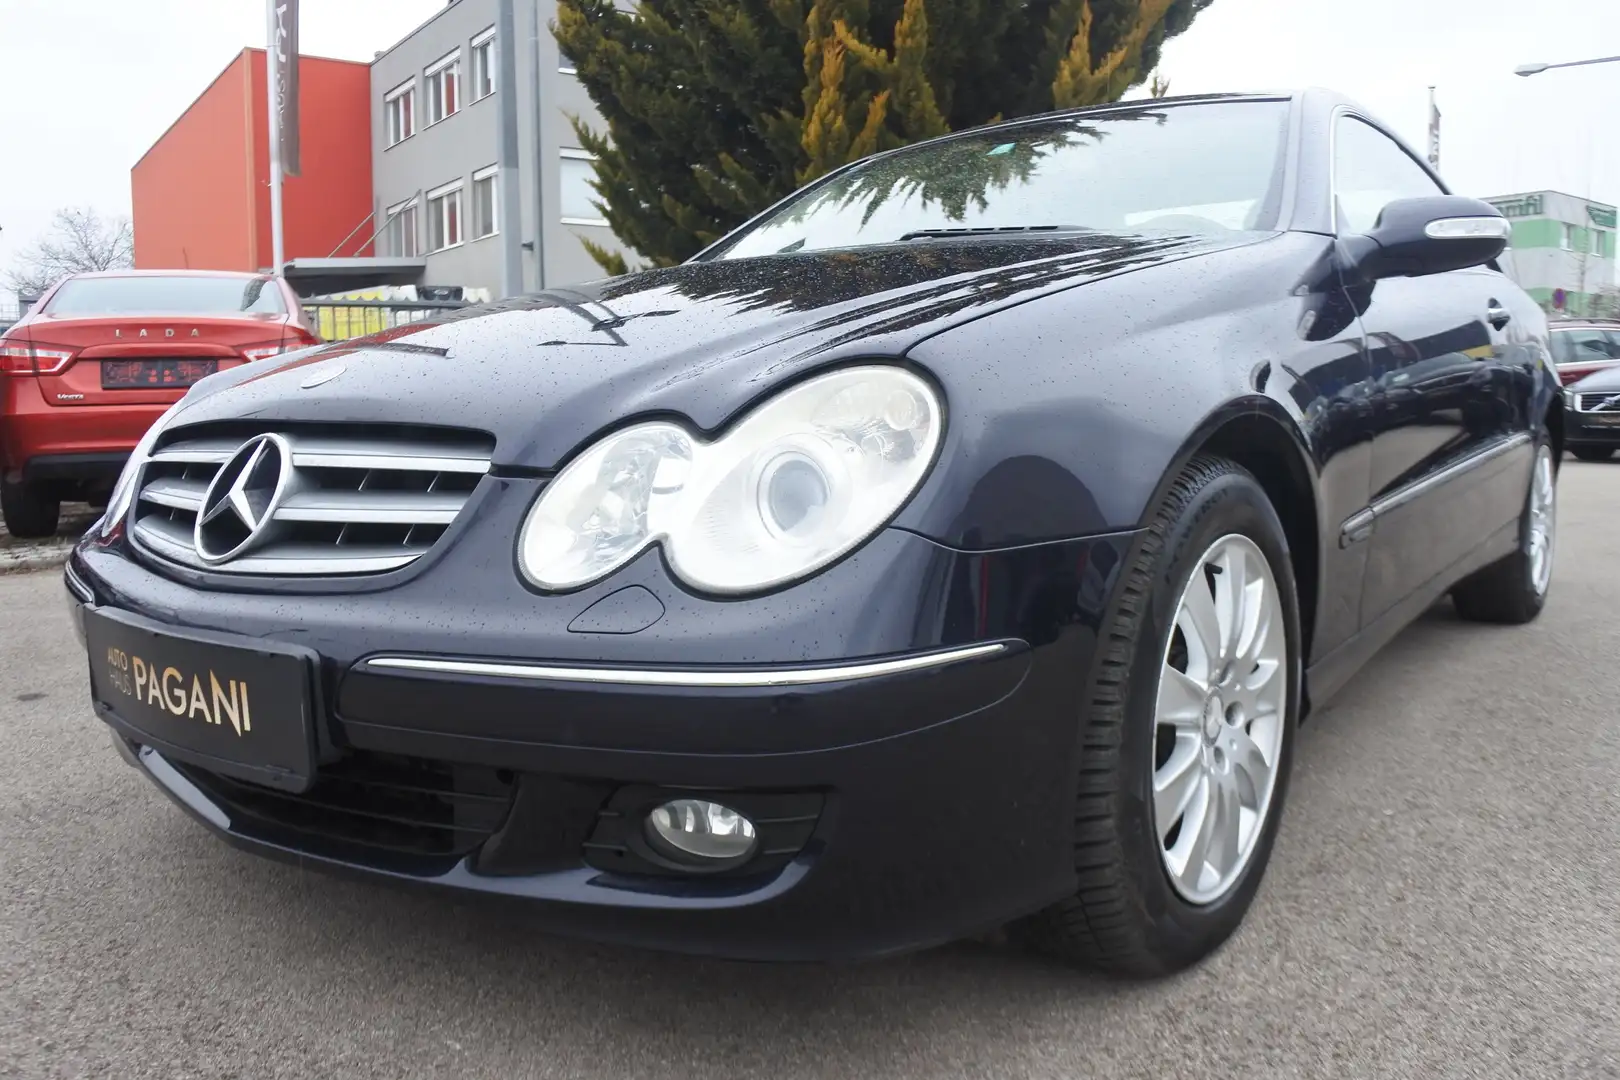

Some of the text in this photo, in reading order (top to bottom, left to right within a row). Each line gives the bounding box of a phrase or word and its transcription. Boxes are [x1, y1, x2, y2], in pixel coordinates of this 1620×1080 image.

[115, 328, 199, 338] LADA
[108, 647, 128, 672] AUTO
[132, 655, 251, 737] PAGANI
